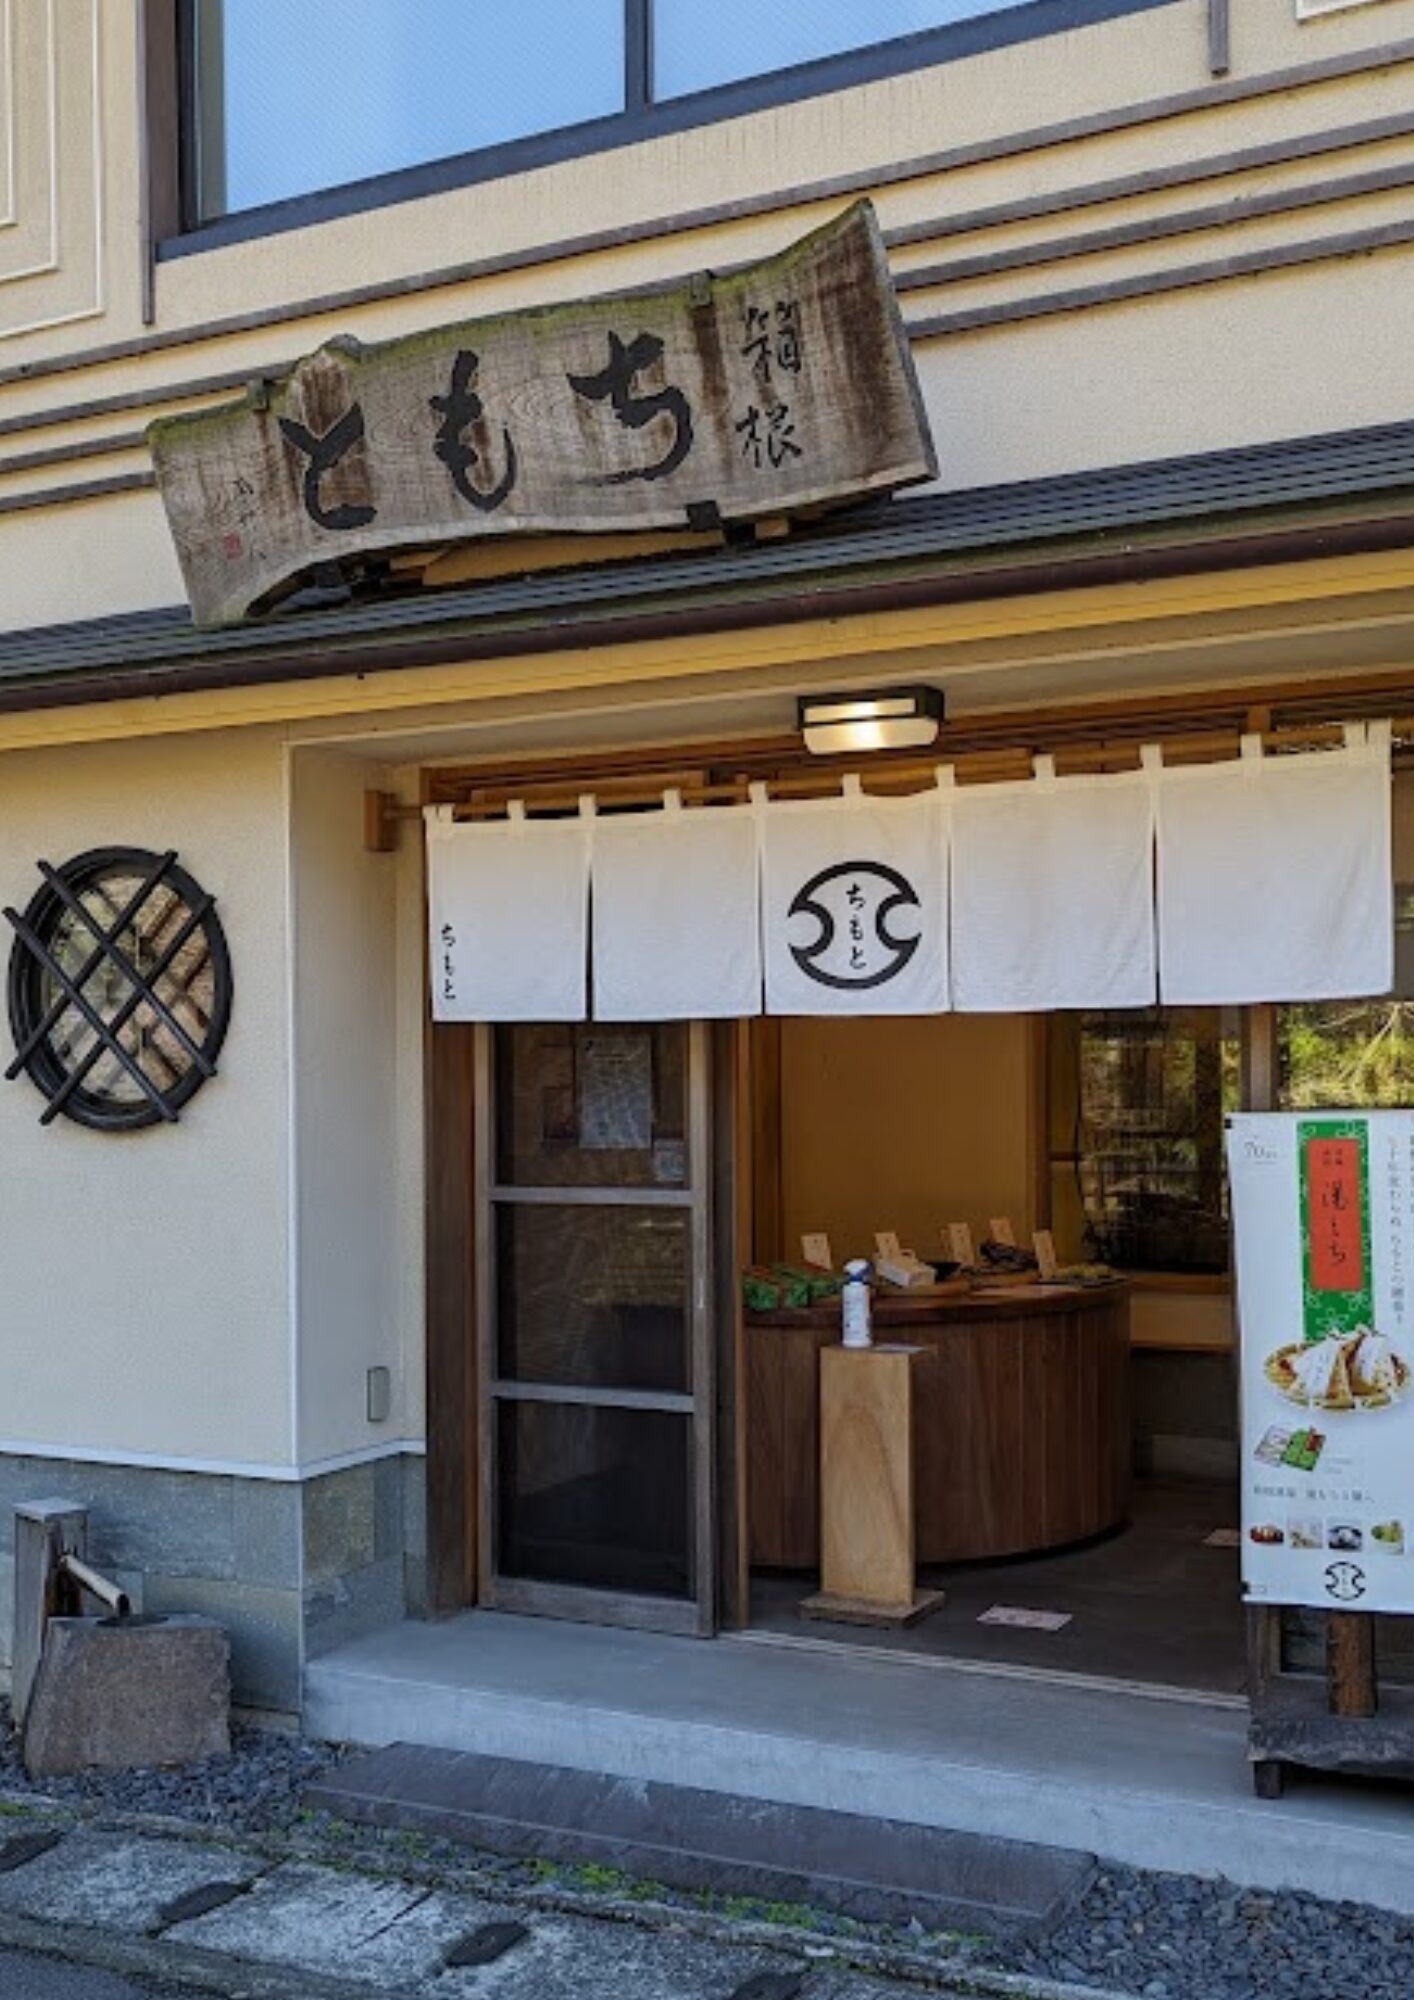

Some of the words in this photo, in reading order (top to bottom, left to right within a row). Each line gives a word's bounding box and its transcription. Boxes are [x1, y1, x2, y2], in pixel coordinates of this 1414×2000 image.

[735, 301, 802, 468] 箱根
[846, 882, 867, 970] ちもと
